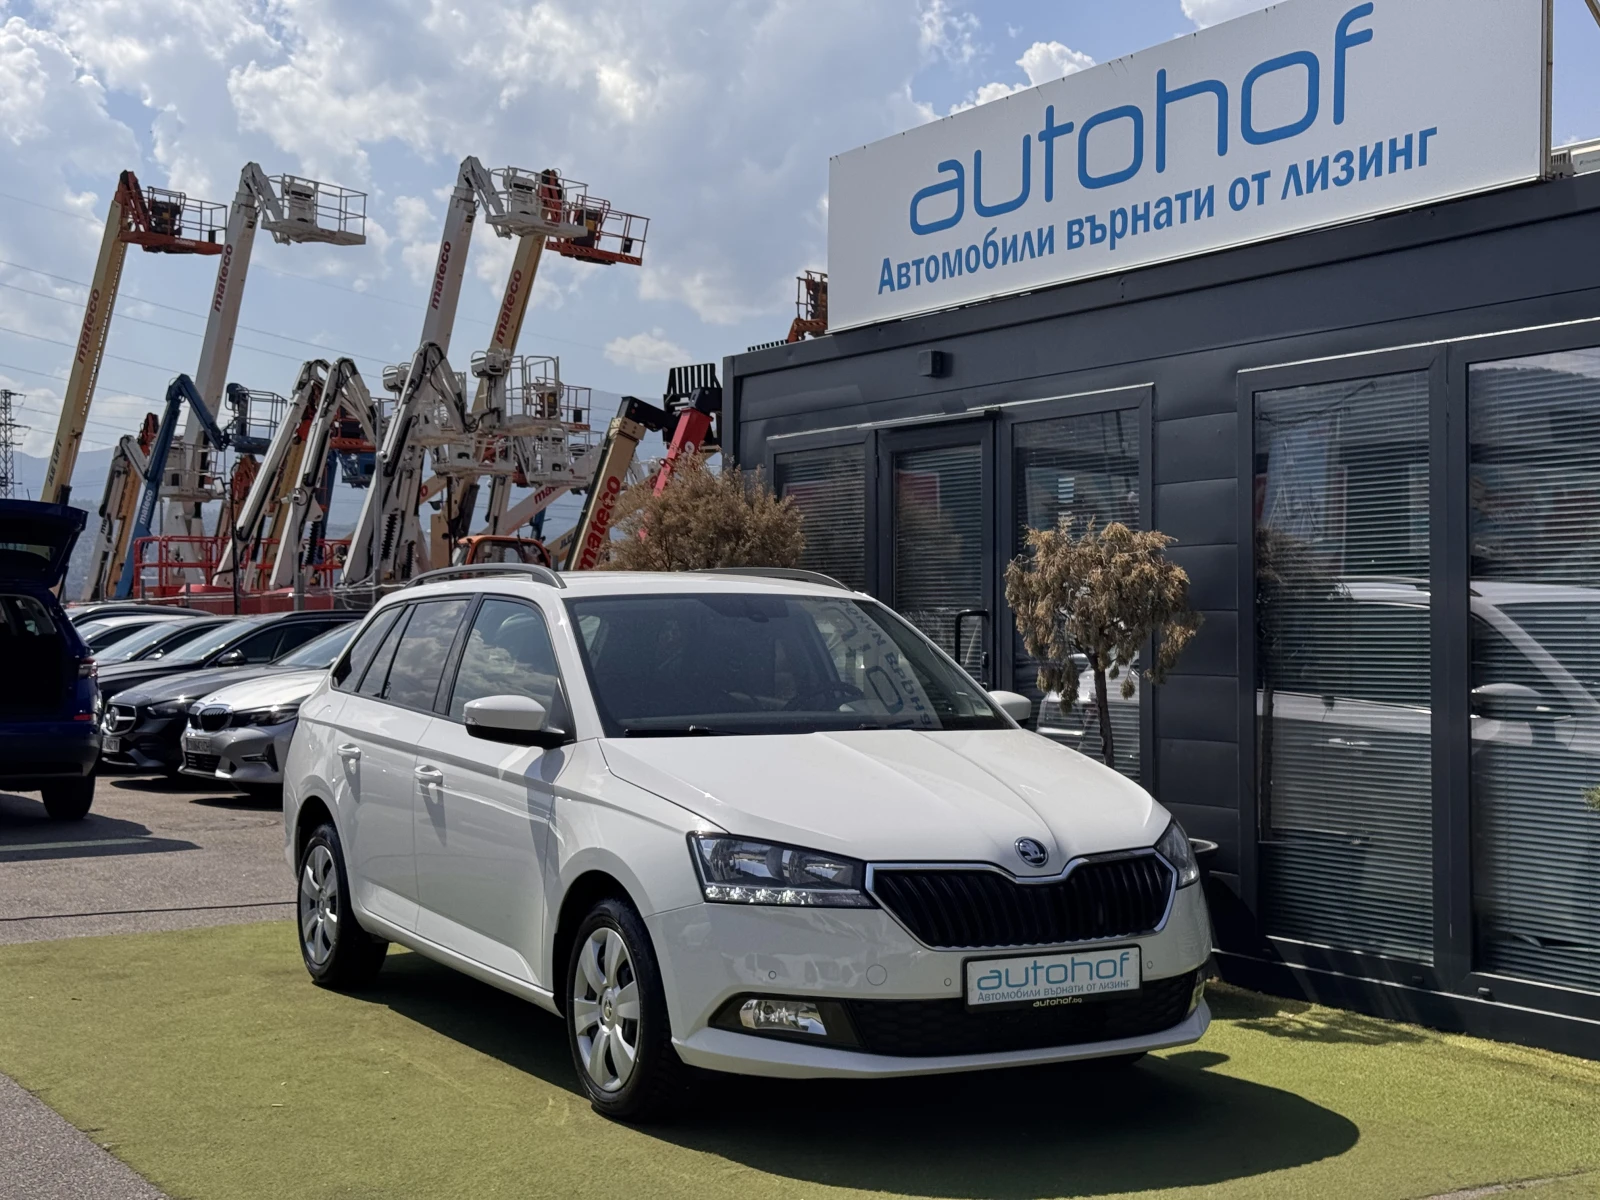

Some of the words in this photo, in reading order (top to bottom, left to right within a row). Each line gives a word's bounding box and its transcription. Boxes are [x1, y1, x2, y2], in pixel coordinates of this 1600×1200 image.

[909, 2, 1374, 236] autohof
[877, 225, 1054, 295] Автомобили
[1067, 185, 1215, 250] върнати
[1228, 171, 1271, 211] от
[1281, 127, 1438, 199] лизинг
[214, 244, 233, 312] mateco
[431, 241, 451, 310] mateco
[495, 269, 522, 344] mateco
[78, 288, 100, 364] mateco
[140, 489, 153, 525] mateco
[578, 475, 621, 570] mateco
[977, 951, 1130, 991] autohof
[977, 987, 1041, 1002] Автомобили
[1043, 983, 1084, 997] върнати
[1086, 982, 1097, 992] от
[1098, 979, 1130, 991] лизинг
